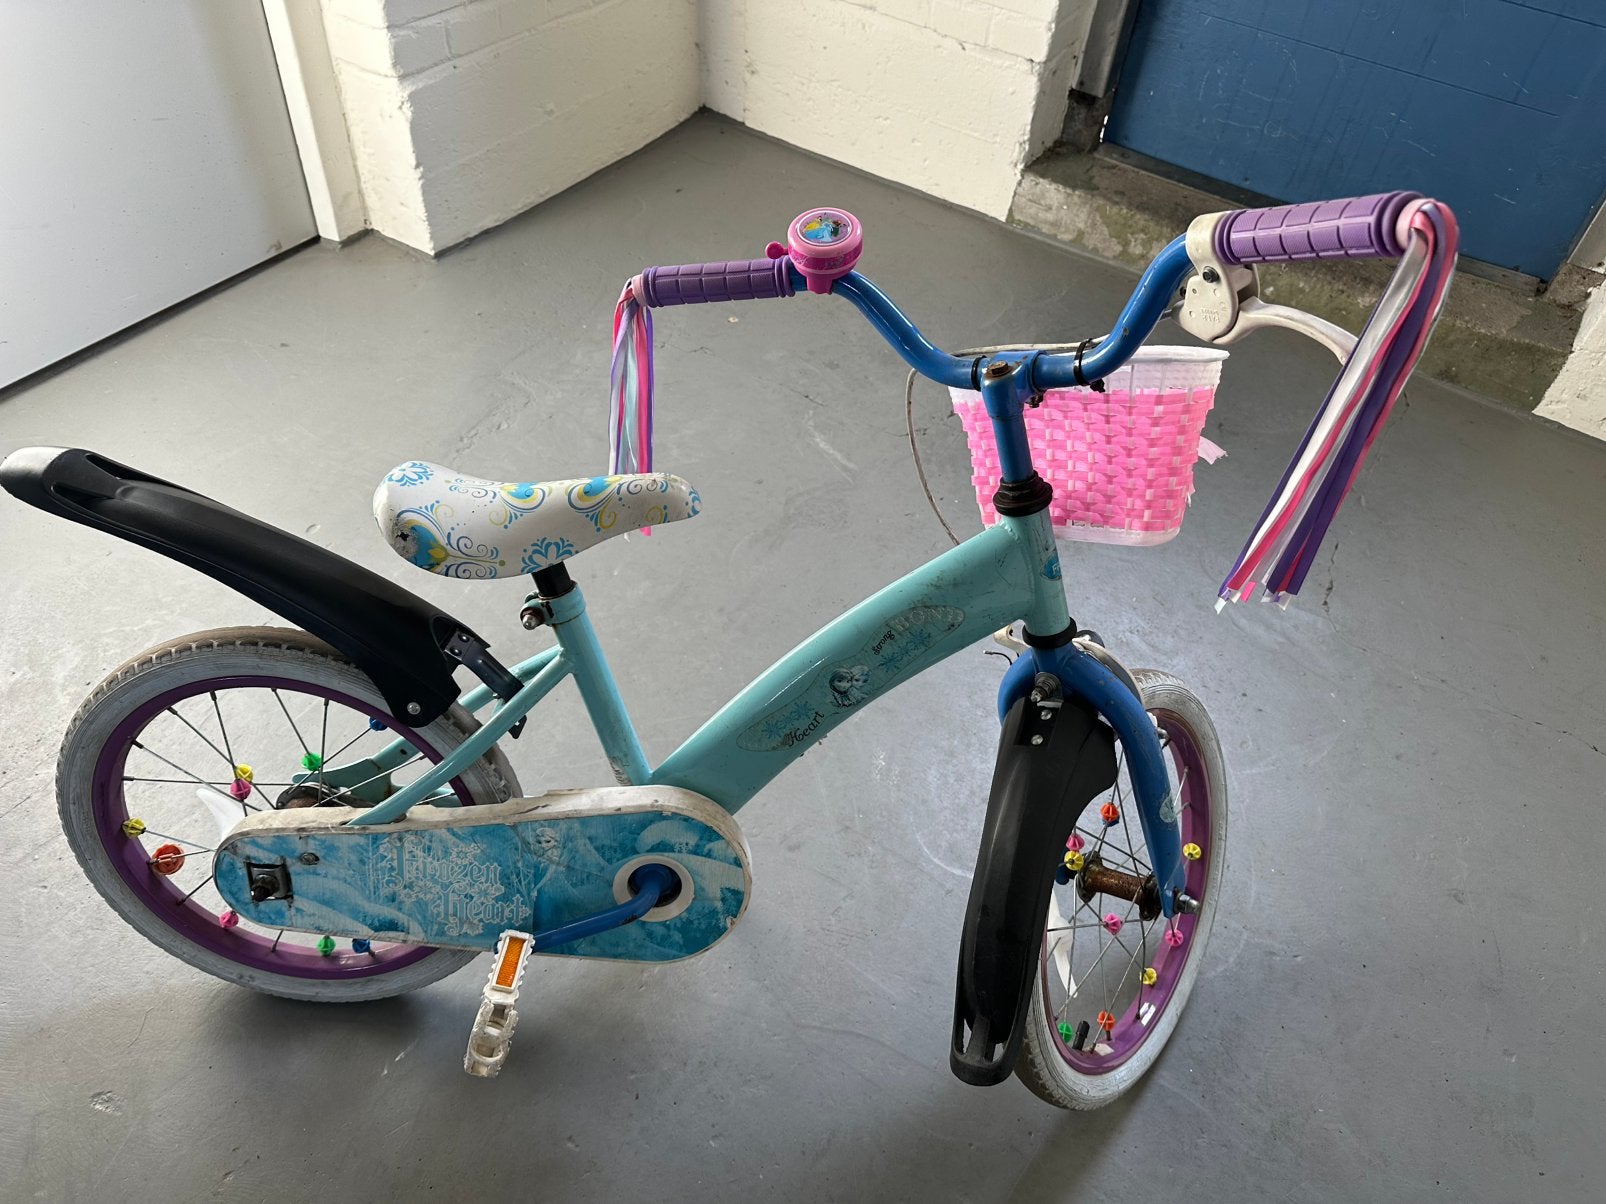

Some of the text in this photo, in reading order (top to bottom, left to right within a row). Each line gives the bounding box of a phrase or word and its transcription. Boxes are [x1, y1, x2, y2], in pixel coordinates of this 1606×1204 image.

[786, 711, 825, 747] Heart
[384, 836, 502, 890] Frozen
[433, 883, 530, 935] Heart
